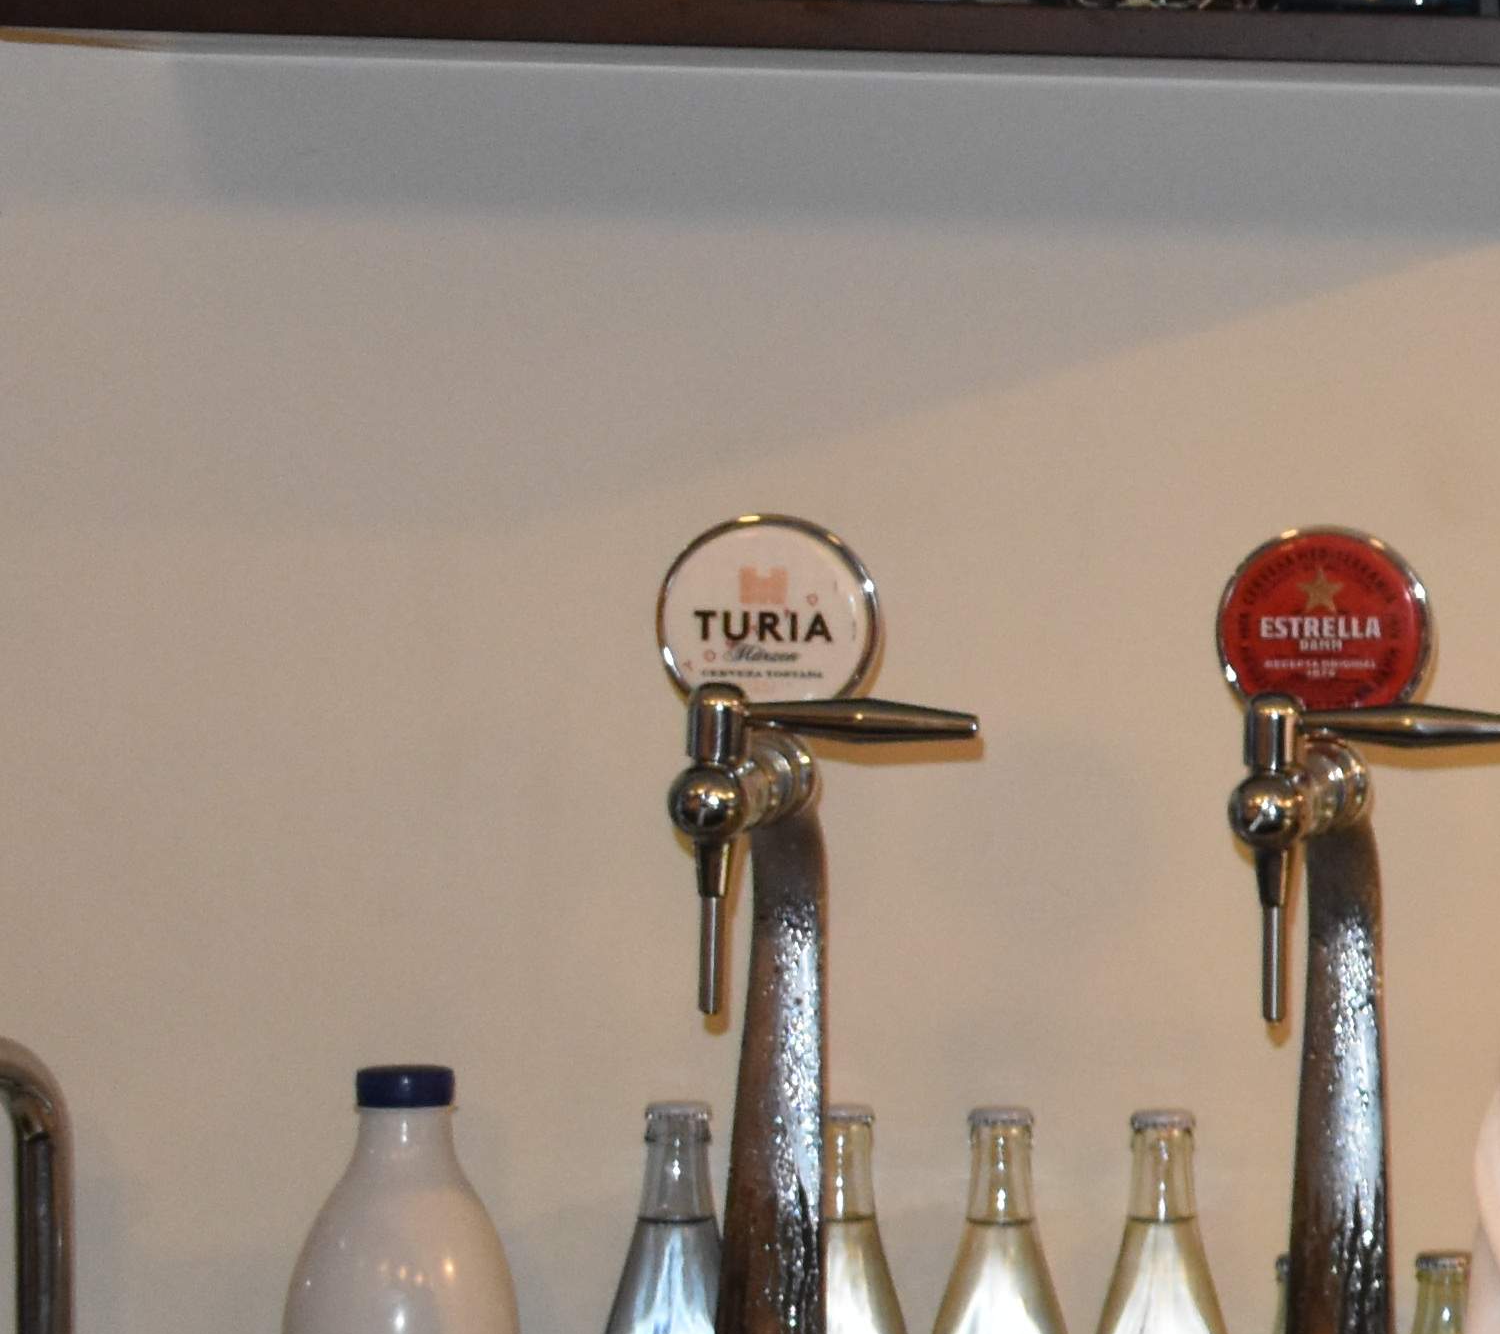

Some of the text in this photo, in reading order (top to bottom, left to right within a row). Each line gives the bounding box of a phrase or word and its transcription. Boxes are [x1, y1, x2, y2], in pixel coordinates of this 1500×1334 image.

[694, 610, 833, 643] TURIA
[1260, 616, 1382, 640] ESTRELLA
[1299, 638, 1343, 652] DAMM
